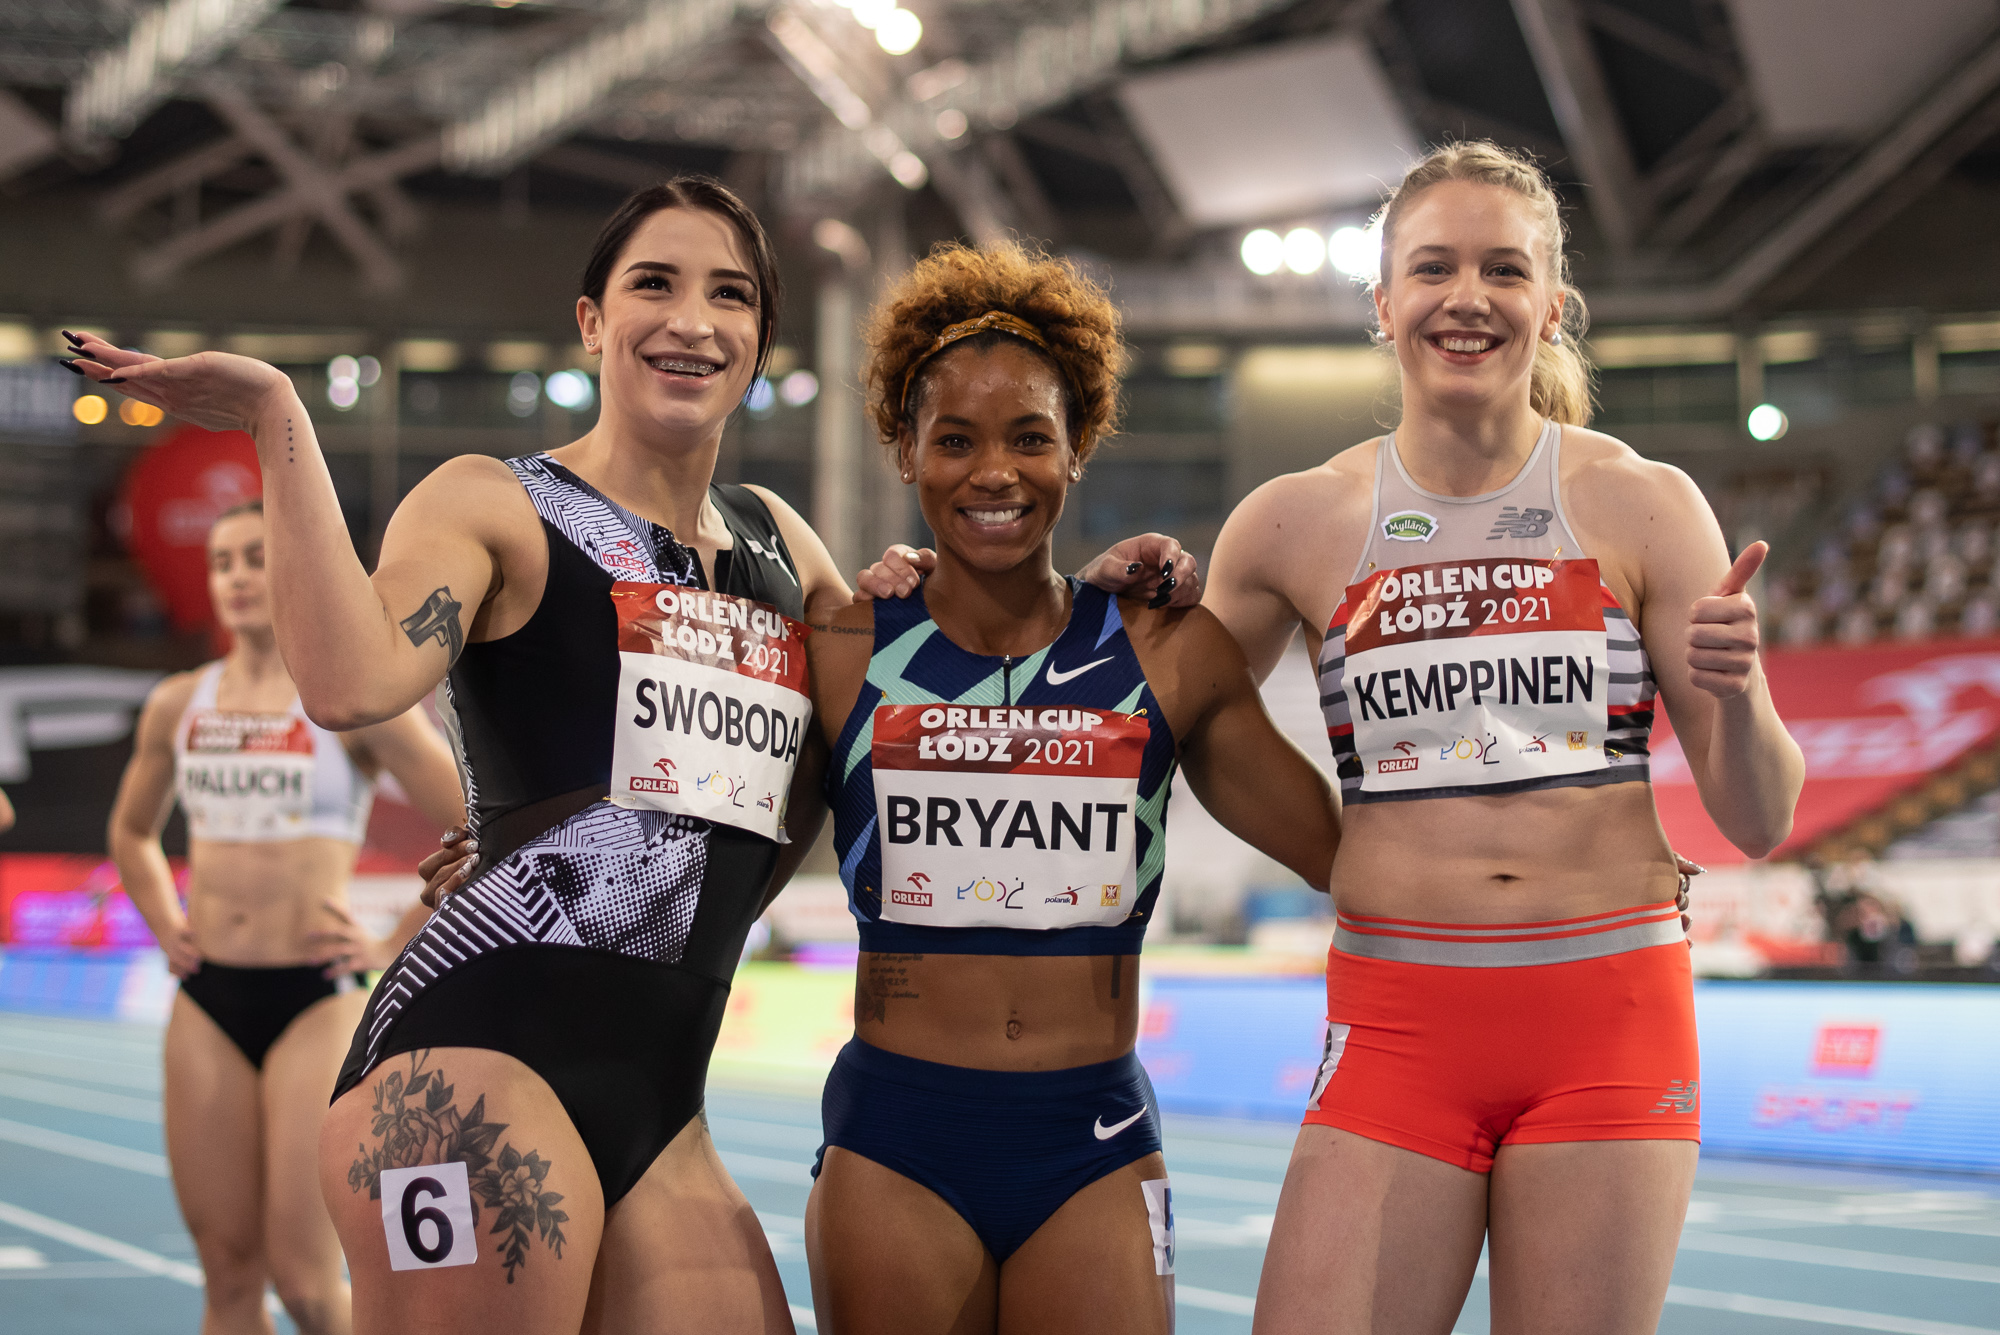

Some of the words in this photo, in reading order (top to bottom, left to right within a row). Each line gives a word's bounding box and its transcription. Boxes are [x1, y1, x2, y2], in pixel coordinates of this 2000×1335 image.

[1389, 519, 1427, 534] Myllärin
[1380, 565, 1487, 602] ORLEN
[1492, 564, 1554, 589] CUP
[656, 590, 747, 630] ORLEN
[1379, 594, 1470, 636] ŁÓDŹ
[1481, 596, 1551, 625] 2021
[661, 619, 735, 660] ŁÓDŹ
[741, 640, 788, 676] 2021
[1354, 655, 1594, 721] KEMPPINEN
[633, 678, 799, 766] SWOBODA
[919, 708, 1033, 730] ORLEN
[1039, 709, 1103, 731] CUP
[918, 729, 1013, 762] ŁÓDŹ
[1023, 738, 1094, 766] 2021
[1380, 758, 1417, 772] ORLEN
[632, 778, 677, 792] ORLEN
[887, 795, 1128, 852] BRYANT
[892, 892, 930, 905] ORLEN
[401, 1177, 454, 1263] 6
